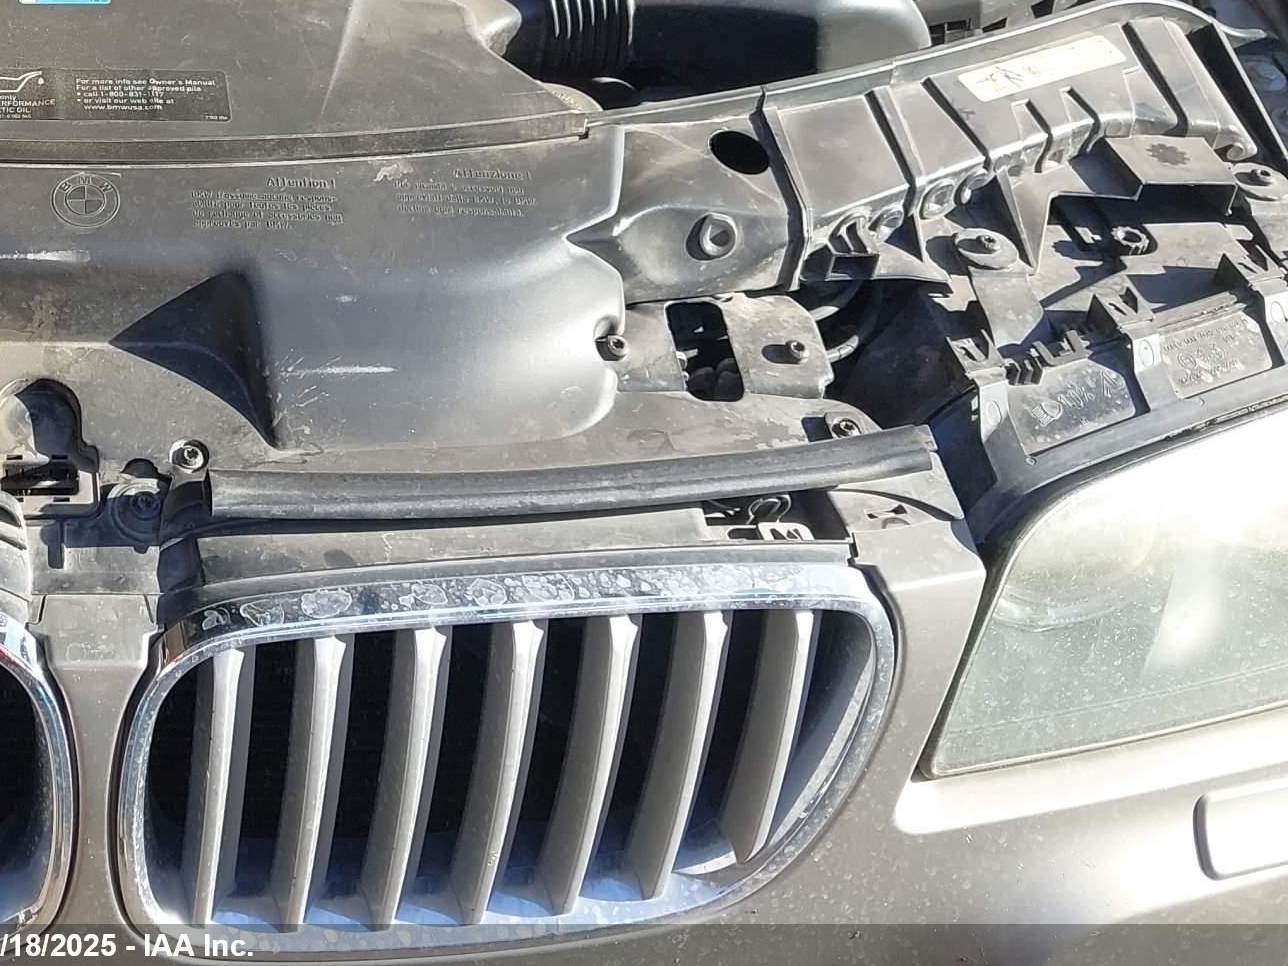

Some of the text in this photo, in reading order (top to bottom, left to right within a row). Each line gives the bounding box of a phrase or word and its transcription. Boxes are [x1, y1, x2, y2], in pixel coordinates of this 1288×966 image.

[115, 77, 132, 85] info
[452, 168, 524, 180] Attenzione
[266, 177, 329, 189] Attention
